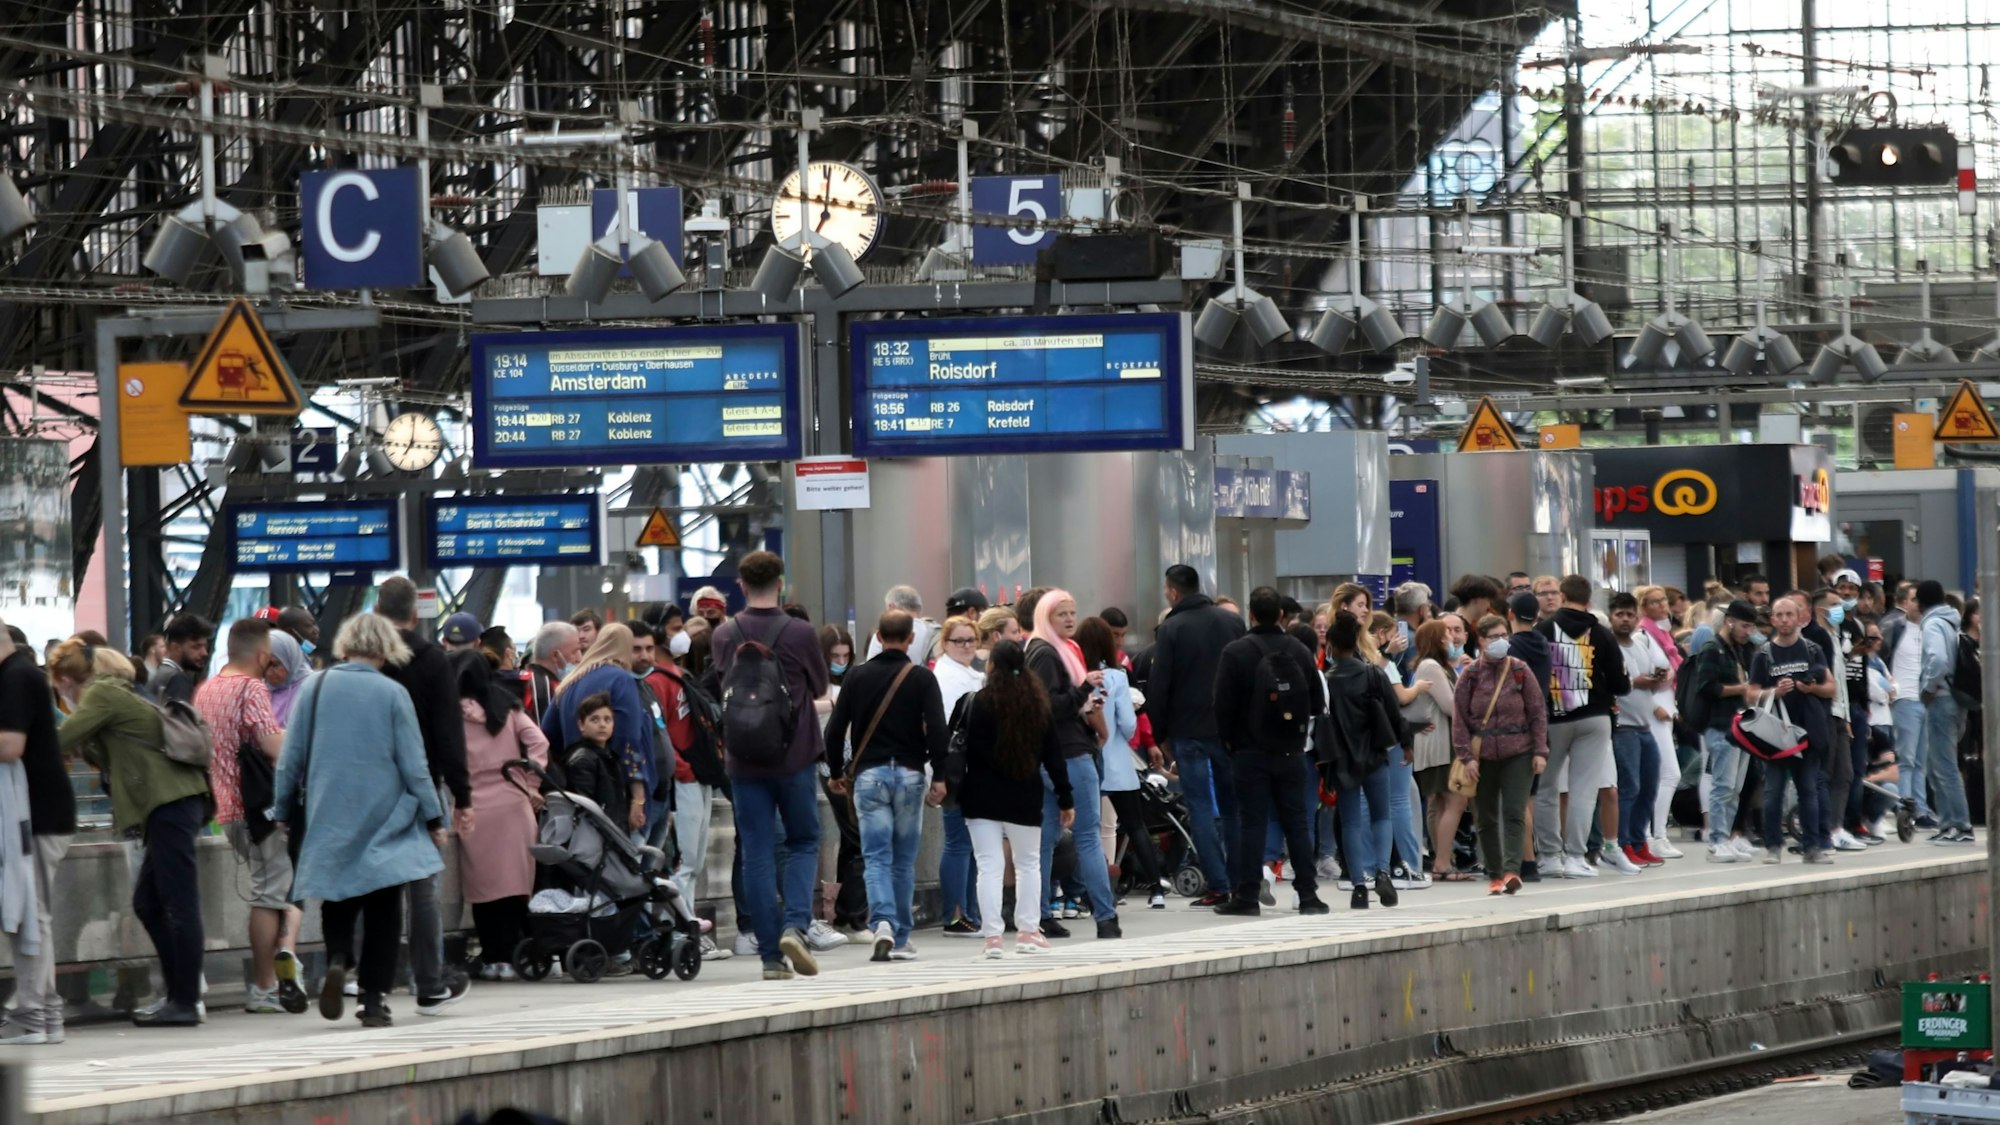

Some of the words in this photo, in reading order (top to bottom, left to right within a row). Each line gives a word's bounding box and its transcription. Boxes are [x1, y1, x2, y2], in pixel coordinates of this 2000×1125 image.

[318, 171, 381, 262] C
[1008, 180, 1046, 245] 5
[874, 342, 909, 356] 18:32
[495, 354, 528, 368] 19:14
[873, 358, 883, 366] RE
[885, 358, 890, 366] 5
[892, 356, 914, 366] (RRX)
[930, 352, 951, 361] Brühl
[493, 370, 506, 378] ICE
[510, 369, 524, 378] 104
[550, 363, 595, 373] Düsseldorf
[602, 362, 638, 372] Duisburg
[646, 360, 694, 370] Oberhausen
[930, 362, 997, 380] Roisdorf
[550, 373, 646, 391] Amsterdam
[493, 404, 529, 413] Folgezüge
[874, 403, 904, 415] 18:56
[930, 403, 944, 412] RB
[947, 402, 960, 412] 26
[987, 400, 1034, 412] Roisdorf
[495, 415, 526, 427] 19:44
[551, 414, 565, 425] RB
[568, 413, 581, 424] 27
[608, 412, 652, 424] Koblenz
[874, 420, 904, 431] 18:41
[931, 419, 944, 429] RE
[948, 419, 954, 428] 7
[988, 417, 1030, 429] Krefeld
[495, 431, 526, 443] 20:44
[551, 430, 565, 441] RB
[568, 430, 581, 440] 27
[608, 429, 652, 440] Koblenz
[297, 429, 320, 463] 2
[466, 519, 492, 529] Berlin
[1918, 1017, 1968, 1033] ERDINGER
